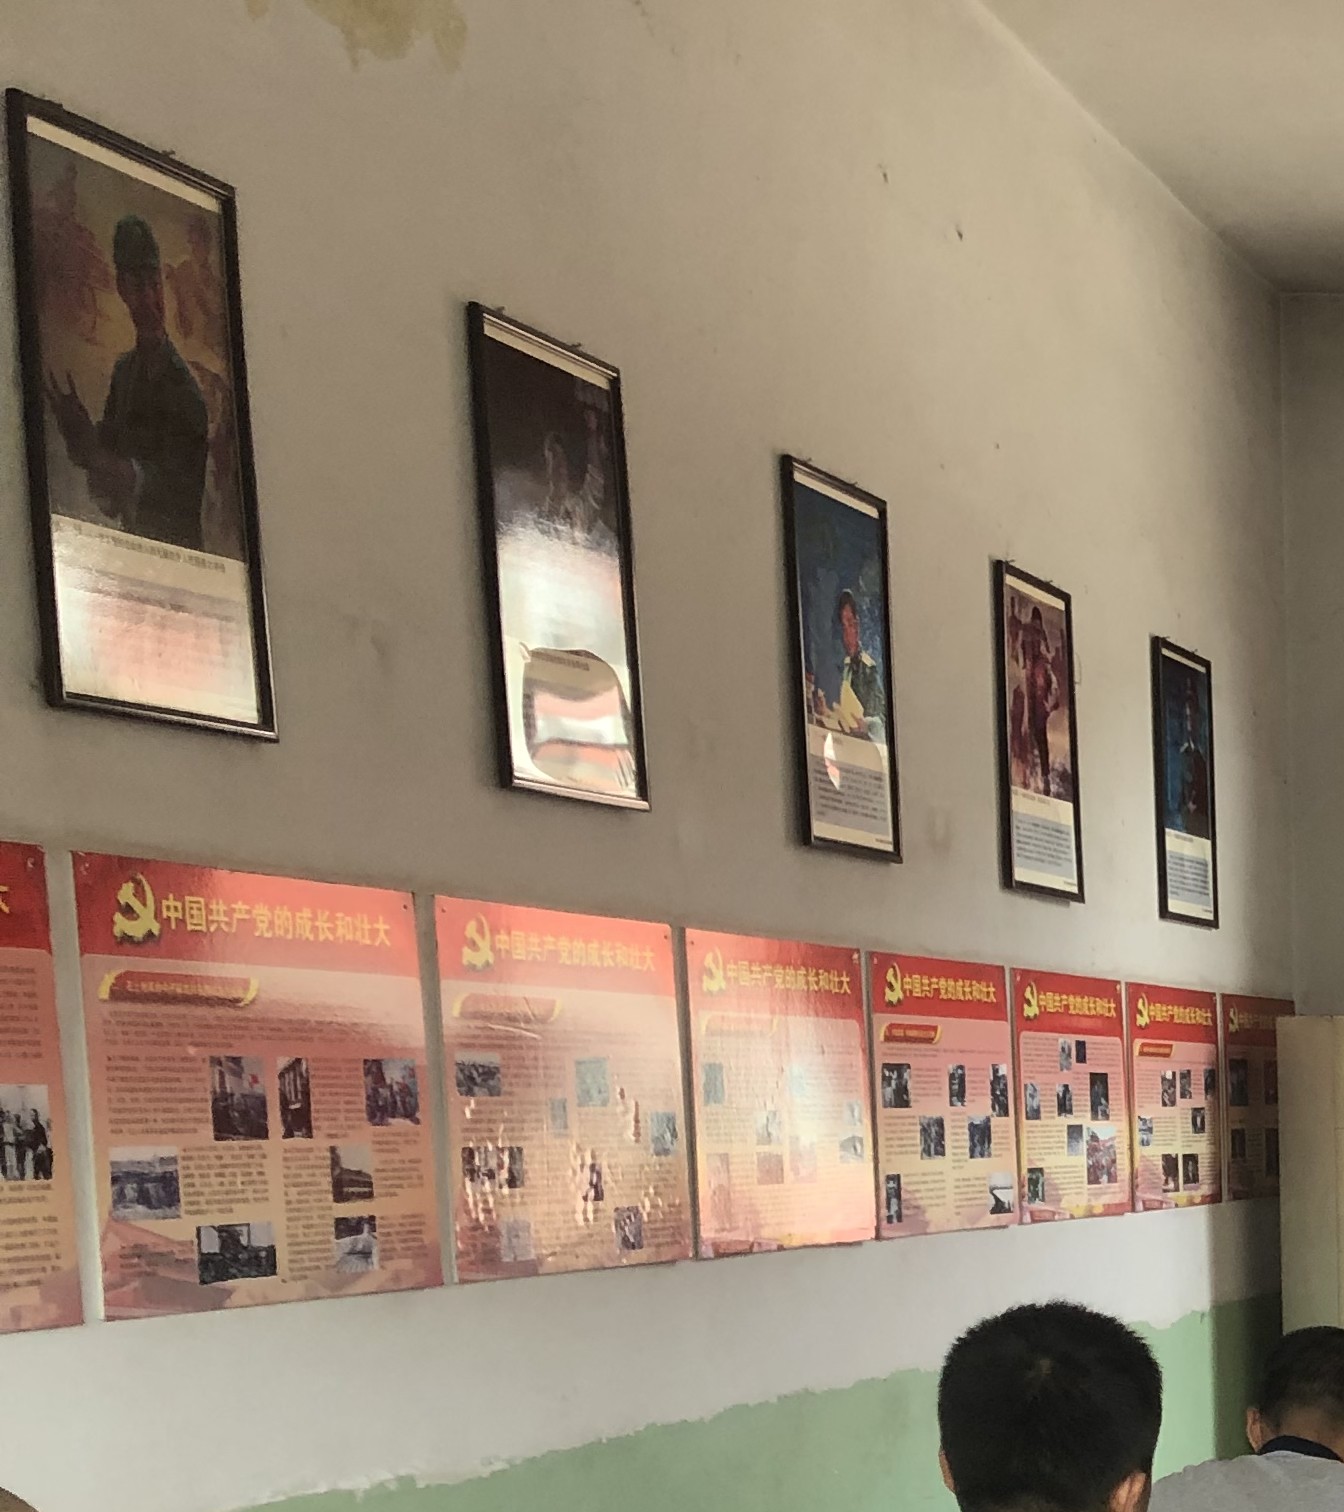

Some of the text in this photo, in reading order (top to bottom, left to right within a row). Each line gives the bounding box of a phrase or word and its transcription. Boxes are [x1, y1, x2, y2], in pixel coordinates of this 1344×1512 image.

[161, 894, 391, 947] 中国共产党的成长和壮大
[495, 930, 656, 972] 中国共产党的成长和壮大
[726, 960, 851, 994] 中国共产党的成长和壮大
